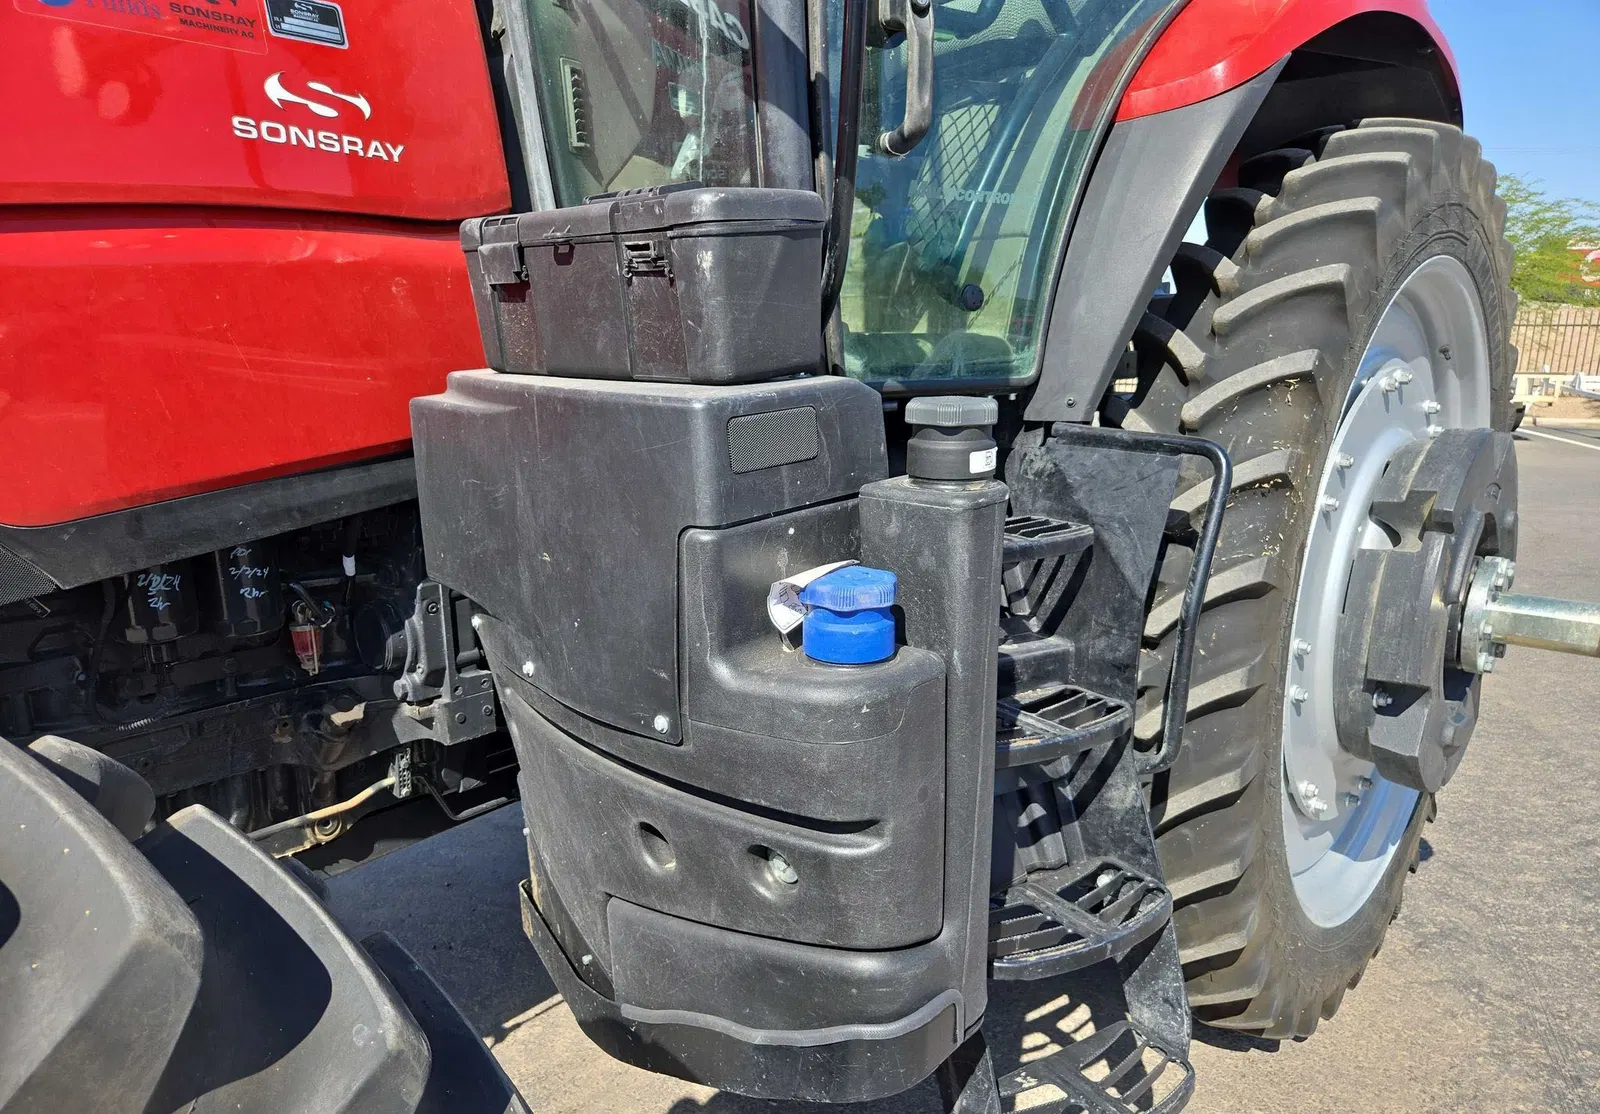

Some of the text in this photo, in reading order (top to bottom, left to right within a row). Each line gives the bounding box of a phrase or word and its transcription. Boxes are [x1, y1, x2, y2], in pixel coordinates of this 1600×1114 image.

[169, 2, 256, 28] SONSRAY
[180, 18, 255, 39] MACHINERY AG
[231, 115, 405, 163] SONSRAY
